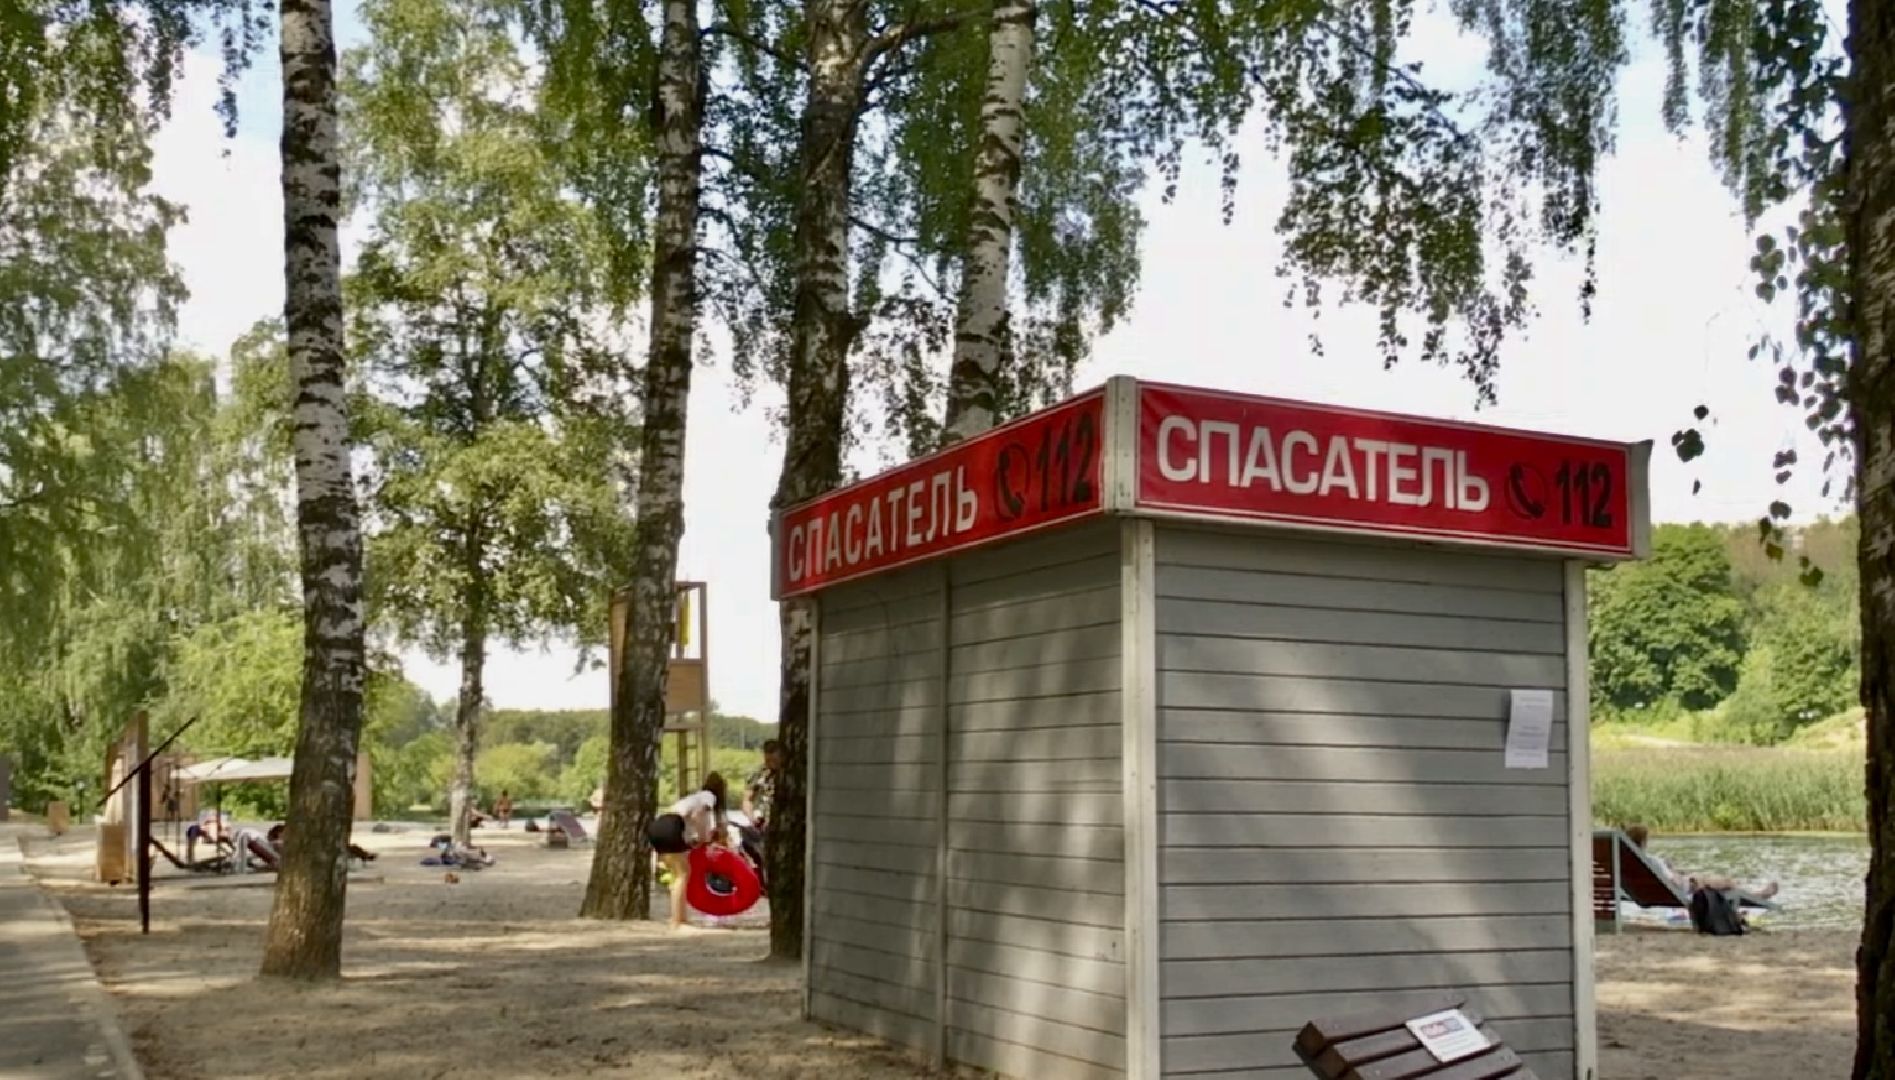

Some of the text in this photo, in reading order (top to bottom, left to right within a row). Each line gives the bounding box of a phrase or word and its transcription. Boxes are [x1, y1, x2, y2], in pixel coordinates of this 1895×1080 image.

[788, 411, 1095, 582] СПАСАТЕЛЬ 112
[1157, 415, 1613, 528] СПАСАТЕЛЬ 112
